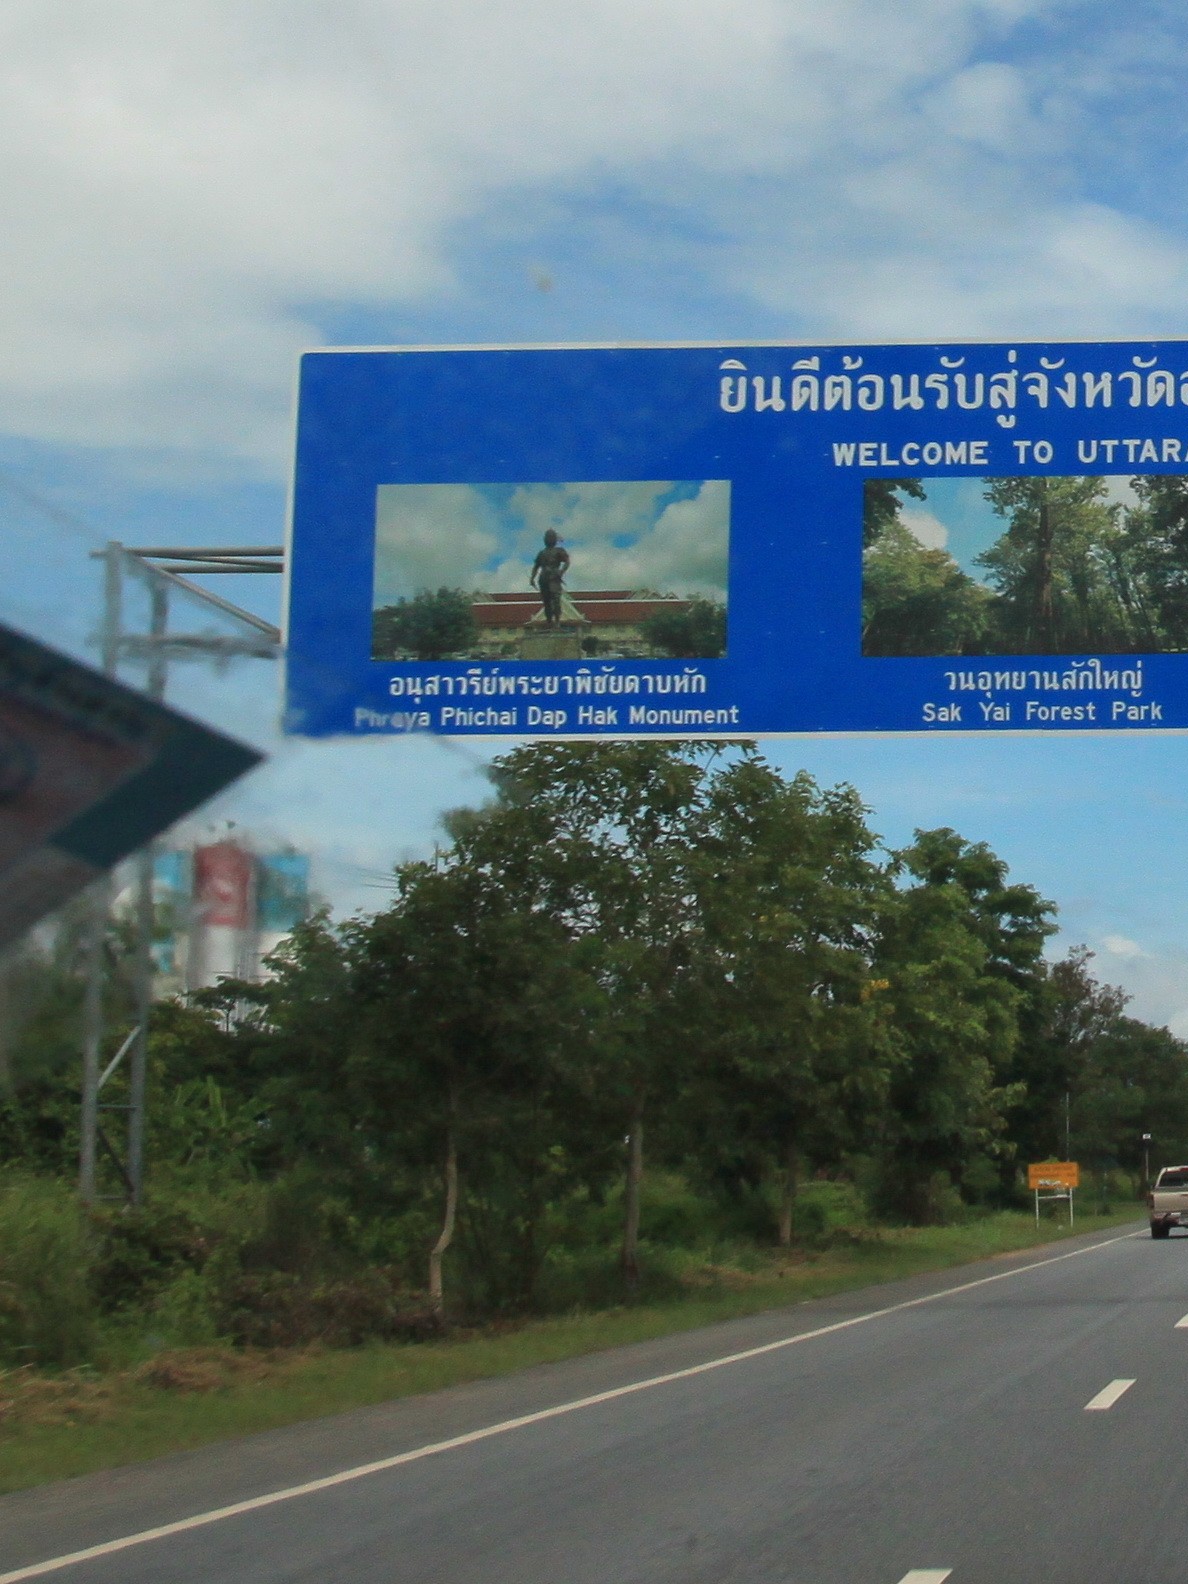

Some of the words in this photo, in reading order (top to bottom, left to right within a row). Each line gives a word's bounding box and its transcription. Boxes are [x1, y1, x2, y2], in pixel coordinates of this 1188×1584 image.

[832, 440, 989, 467] WELCOME
[1014, 439, 1054, 465] TO
[389, 666, 707, 704] อนุสาวรีย์พระยาพิชัยดาบหัก
[944, 658, 1143, 698] วนอุทยานสักใหญ่
[440, 706, 518, 727] Phichai
[527, 705, 567, 729] Dap
[577, 705, 618, 726] Hak
[628, 705, 740, 726] Monument
[922, 702, 962, 722] Sak
[979, 701, 1011, 722] Yai
[1025, 701, 1096, 721] Forest
[1112, 700, 1163, 721] Park
